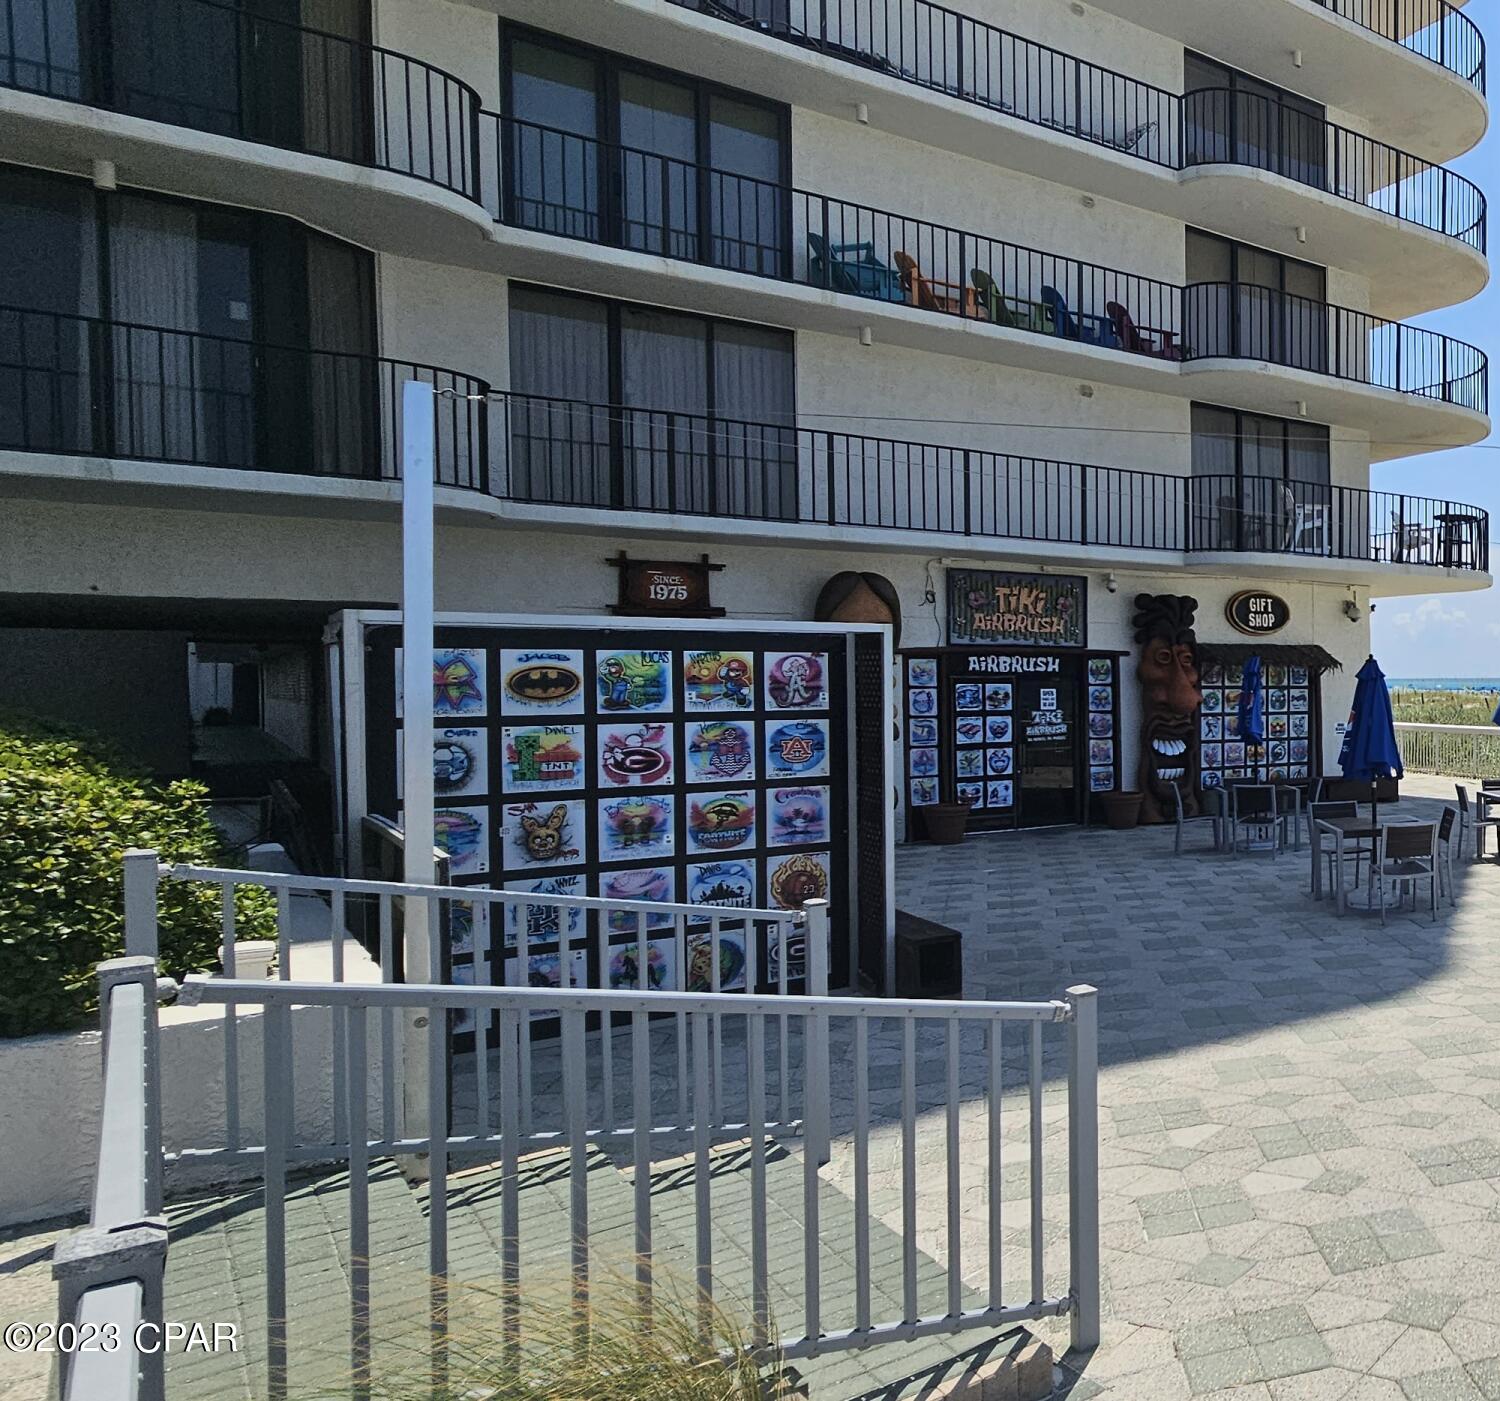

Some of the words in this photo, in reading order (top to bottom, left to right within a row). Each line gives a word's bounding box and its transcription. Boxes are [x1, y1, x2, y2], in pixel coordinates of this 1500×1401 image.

[653, 575, 682, 585] SINCE
[649, 584, 688, 600] 1975
[1249, 598, 1273, 612] GIFT
[1248, 613, 1275, 627] SHOP
[518, 653, 571, 663] JACOB
[641, 651, 670, 666] LUCAS
[545, 762, 569, 770] TNT
[803, 884, 816, 894] 23
